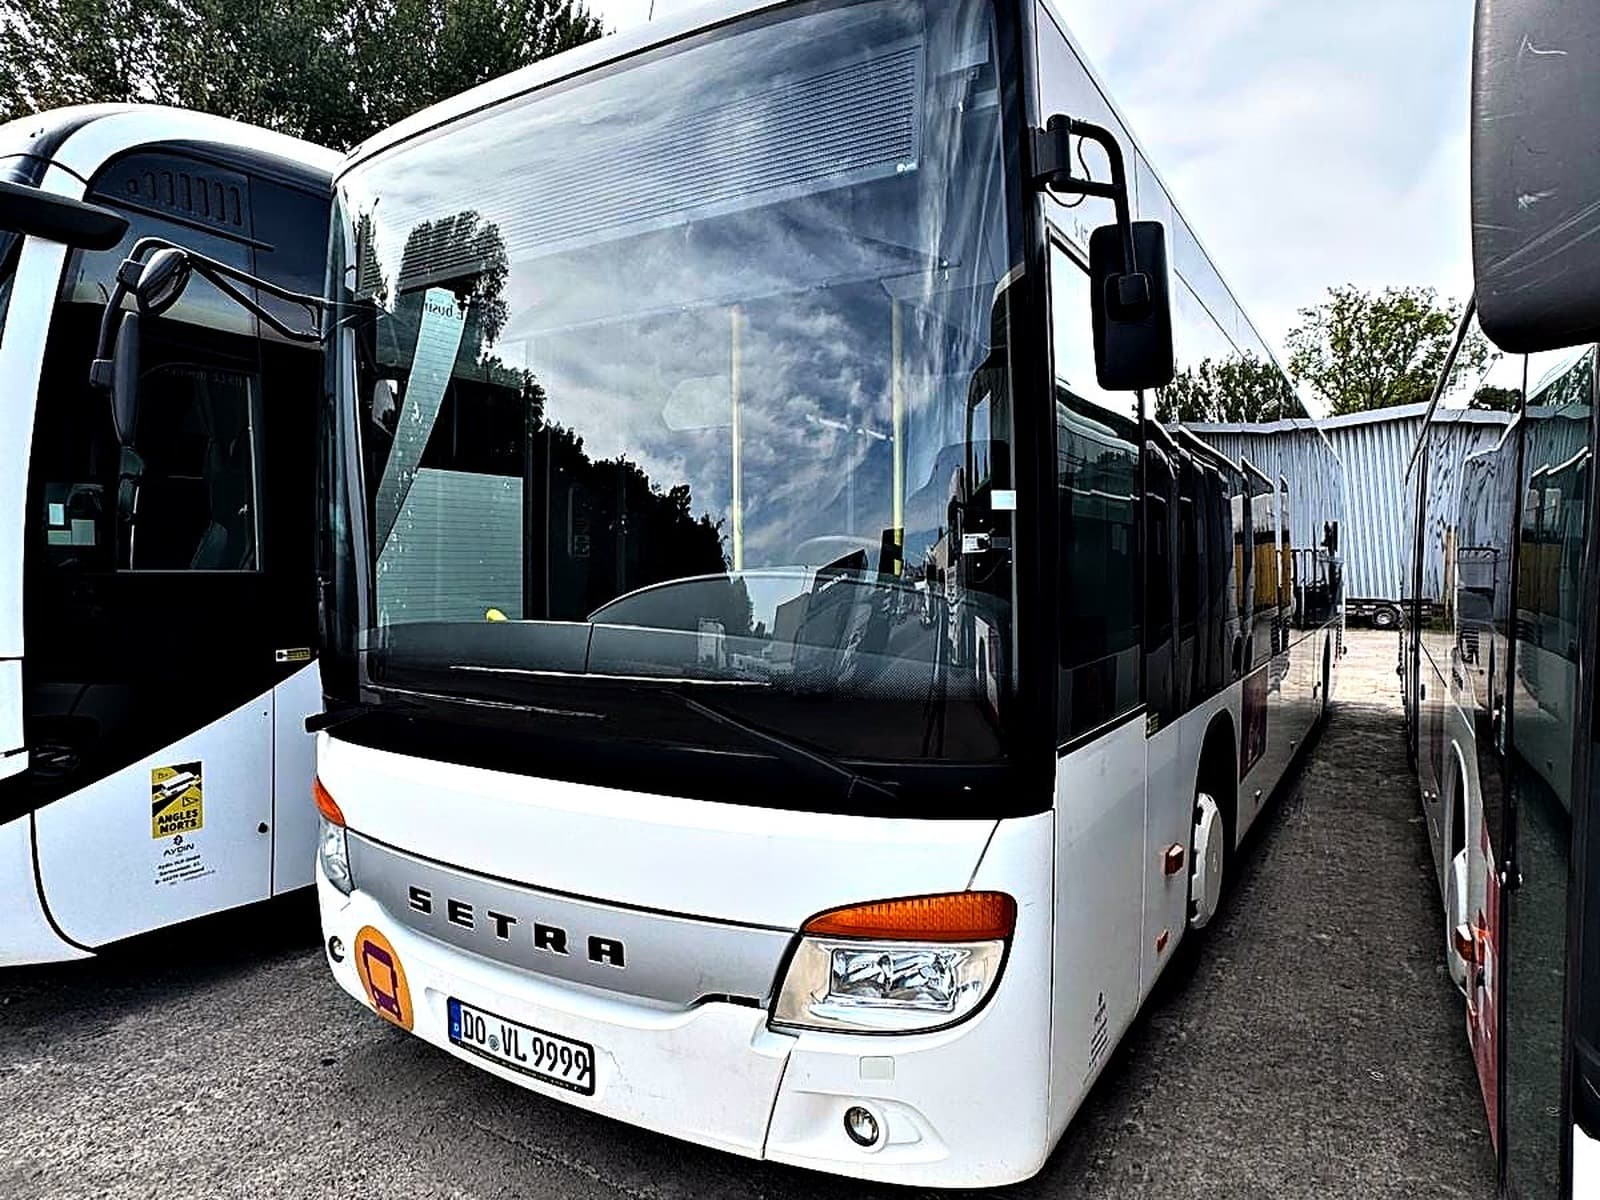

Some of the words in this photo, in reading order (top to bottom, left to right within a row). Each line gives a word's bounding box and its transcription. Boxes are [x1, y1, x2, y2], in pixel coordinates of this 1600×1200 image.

[158, 808, 198, 824] ANGLES
[408, 885, 626, 968] SETRA
[462, 1009, 487, 1045] DO
[501, 1024, 528, 1063] VL
[532, 1036, 590, 1082] 9999
